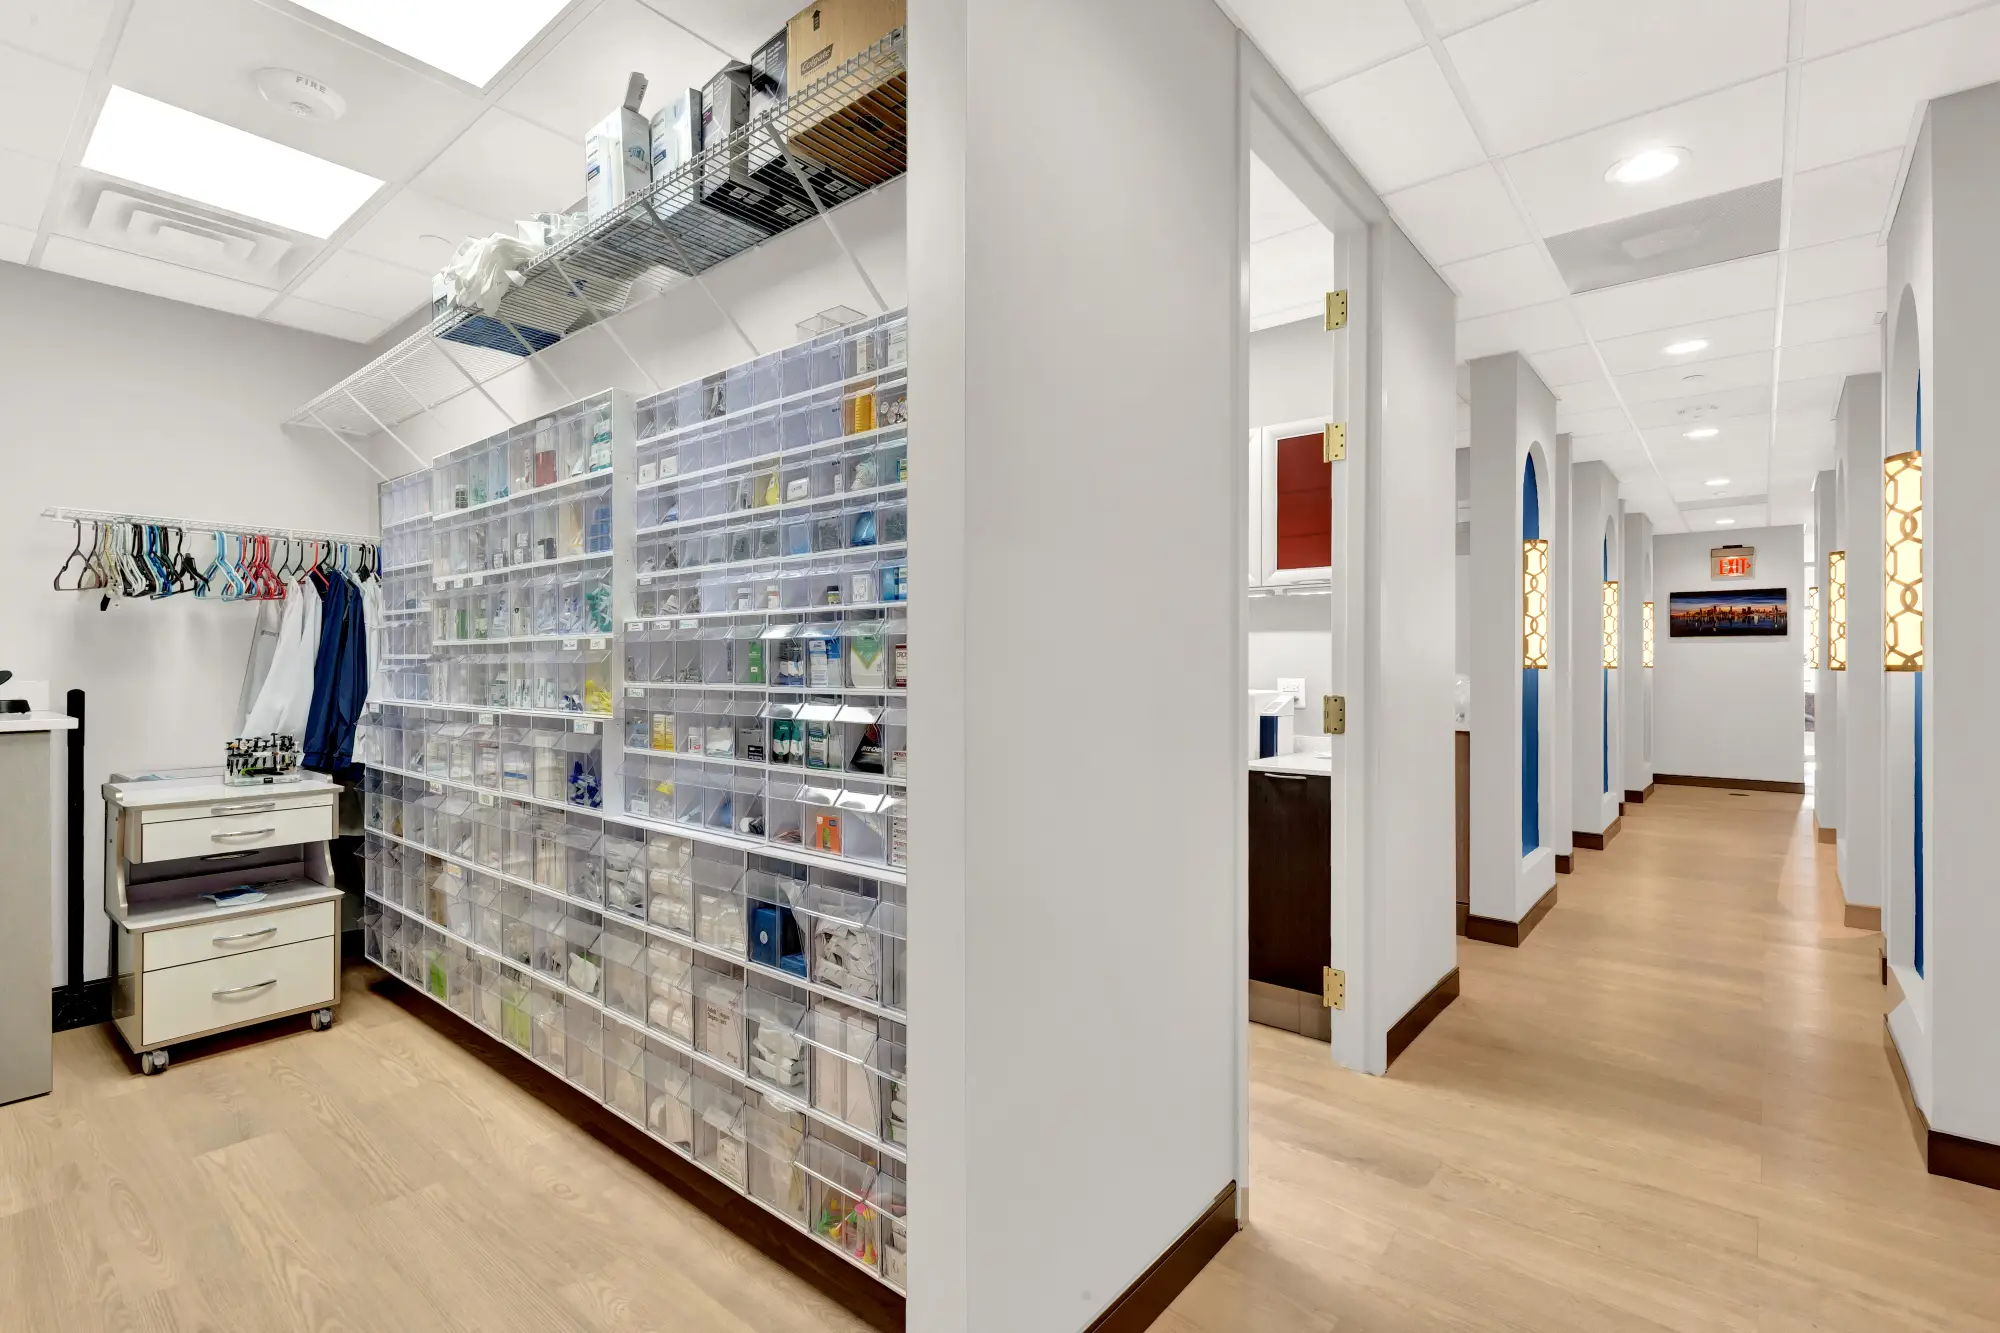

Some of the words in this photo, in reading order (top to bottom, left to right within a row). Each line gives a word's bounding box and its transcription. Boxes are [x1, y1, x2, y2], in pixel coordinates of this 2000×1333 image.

[801, 48, 832, 73] Colgate
[295, 75, 327, 94] FIRE
[1719, 557, 1748, 576] EXIT
